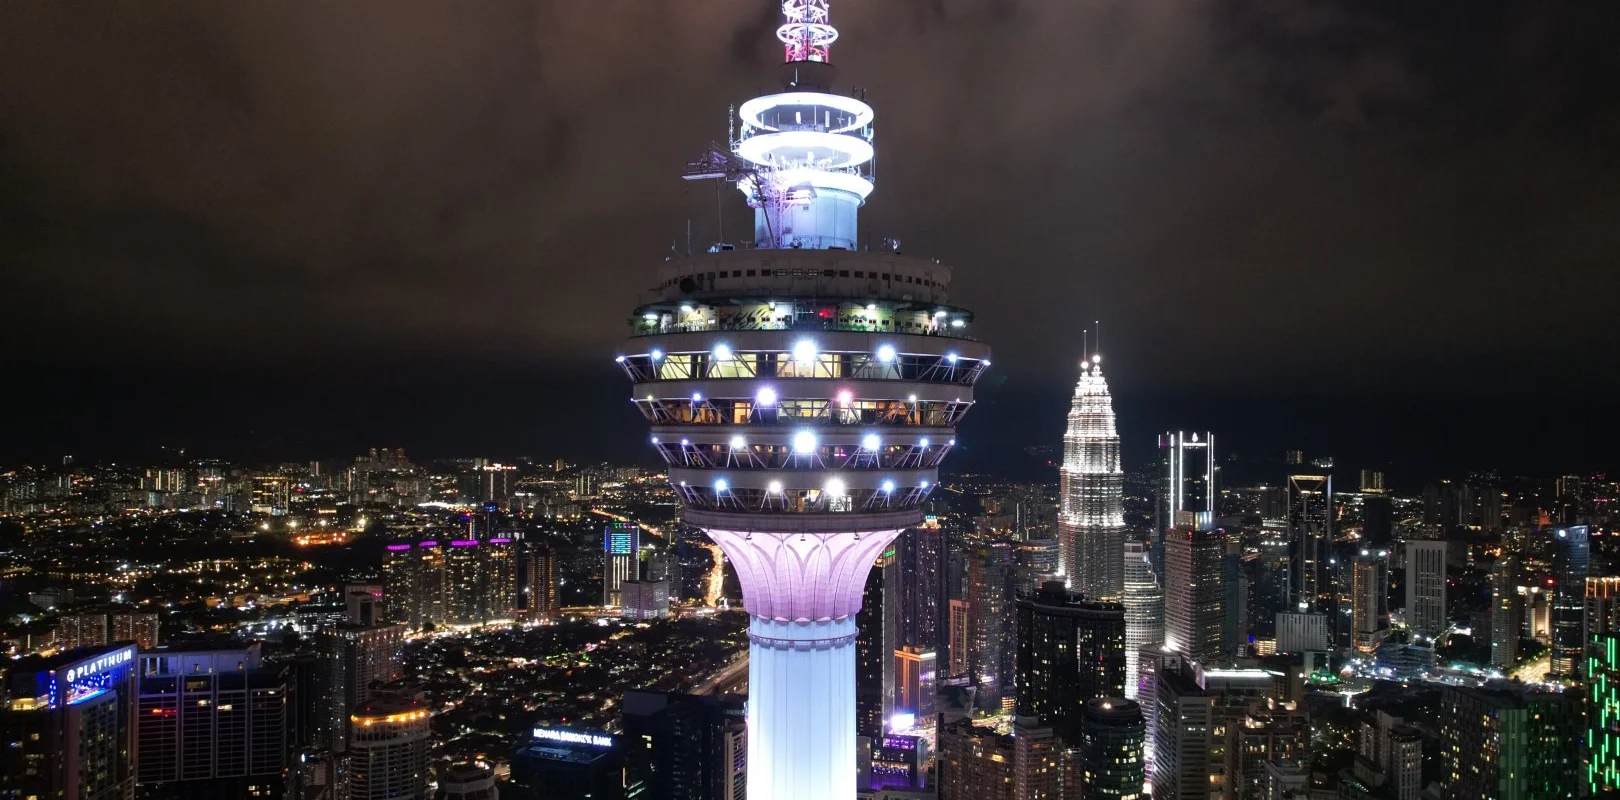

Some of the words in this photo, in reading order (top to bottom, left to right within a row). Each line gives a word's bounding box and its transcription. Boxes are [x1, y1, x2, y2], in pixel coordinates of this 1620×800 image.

[77, 649, 132, 678] PLATINUM
[533, 728, 561, 740] MENARA
[561, 731, 592, 744] BANGKOK
[592, 735, 612, 747] BANK
